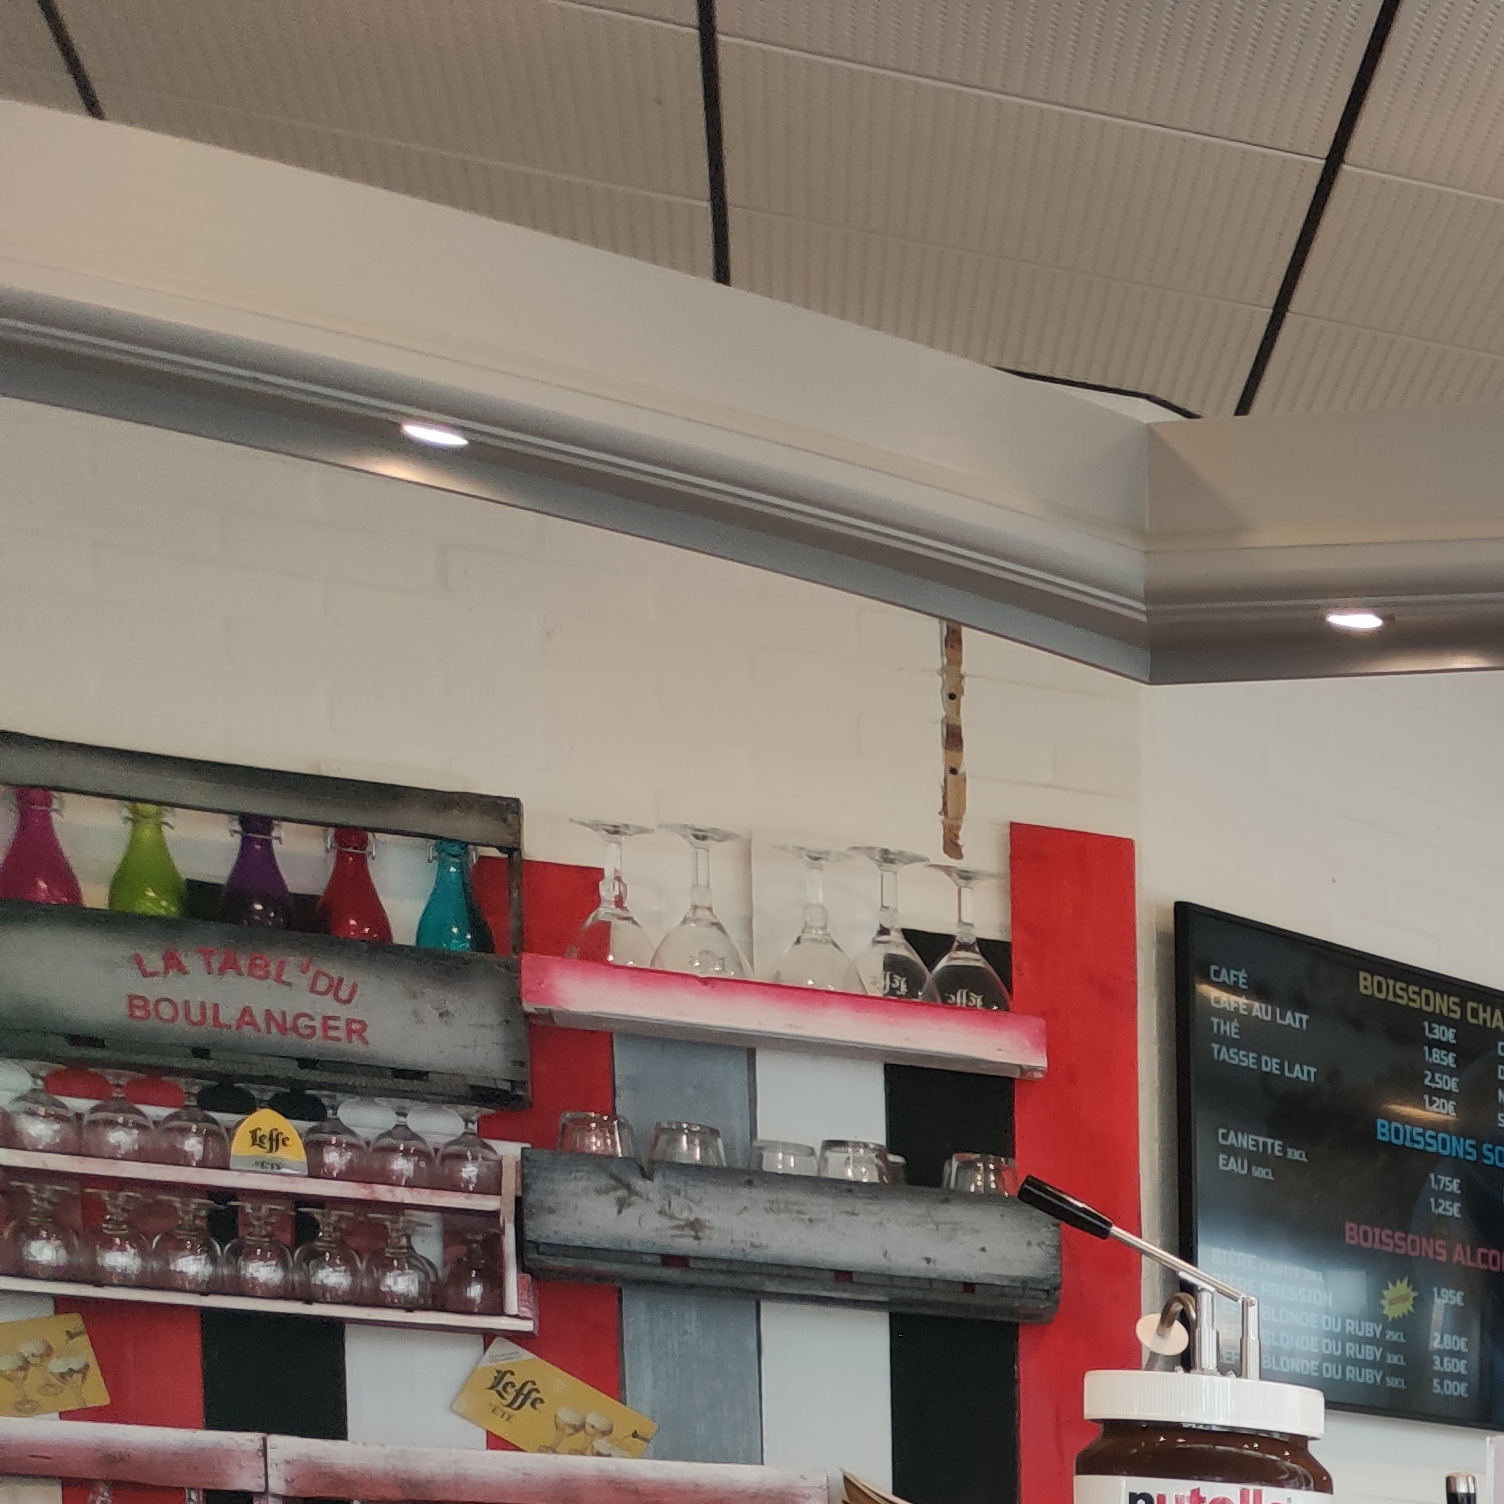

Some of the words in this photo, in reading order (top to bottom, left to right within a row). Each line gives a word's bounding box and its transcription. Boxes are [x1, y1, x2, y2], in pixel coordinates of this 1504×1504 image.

[135, 949, 189, 977] LA
[1210, 964, 1248, 989] CAFÉ
[1210, 992, 1248, 1015] CAFÉ
[1252, 1002, 1271, 1020] AU
[1276, 1007, 1309, 1030] LAIT
[1359, 971, 1461, 1019] BOISSONS
[127, 994, 369, 1045] BOULANGER
[1210, 1016, 1240, 1039] THÉ
[1211, 1043, 1257, 1068] TASSE
[1262, 1057, 1280, 1075] DE
[1284, 1060, 1317, 1082] LAIT
[248, 1127, 291, 1153] Leffe
[1218, 1128, 1283, 1156] CANETTE
[1376, 1118, 1477, 1162] BOISSONS
[1219, 1154, 1247, 1174] EAU
[1345, 1221, 1447, 1263] BOISSONS
[1261, 1280, 1332, 1308] PRESSION
[1261, 1305, 1318, 1328] BLONDE
[1322, 1315, 1341, 1332] OU
[1346, 1319, 1383, 1342] RUBY
[1261, 1330, 1318, 1353] BLONDE
[1322, 1338, 1341, 1355] OU
[1346, 1342, 1383, 1363] RUBY
[1261, 1353, 1318, 1375] BLONDE
[1322, 1362, 1341, 1379] OU
[1346, 1366, 1383, 1386] RUBY
[486, 1369, 545, 1411] Leffe
